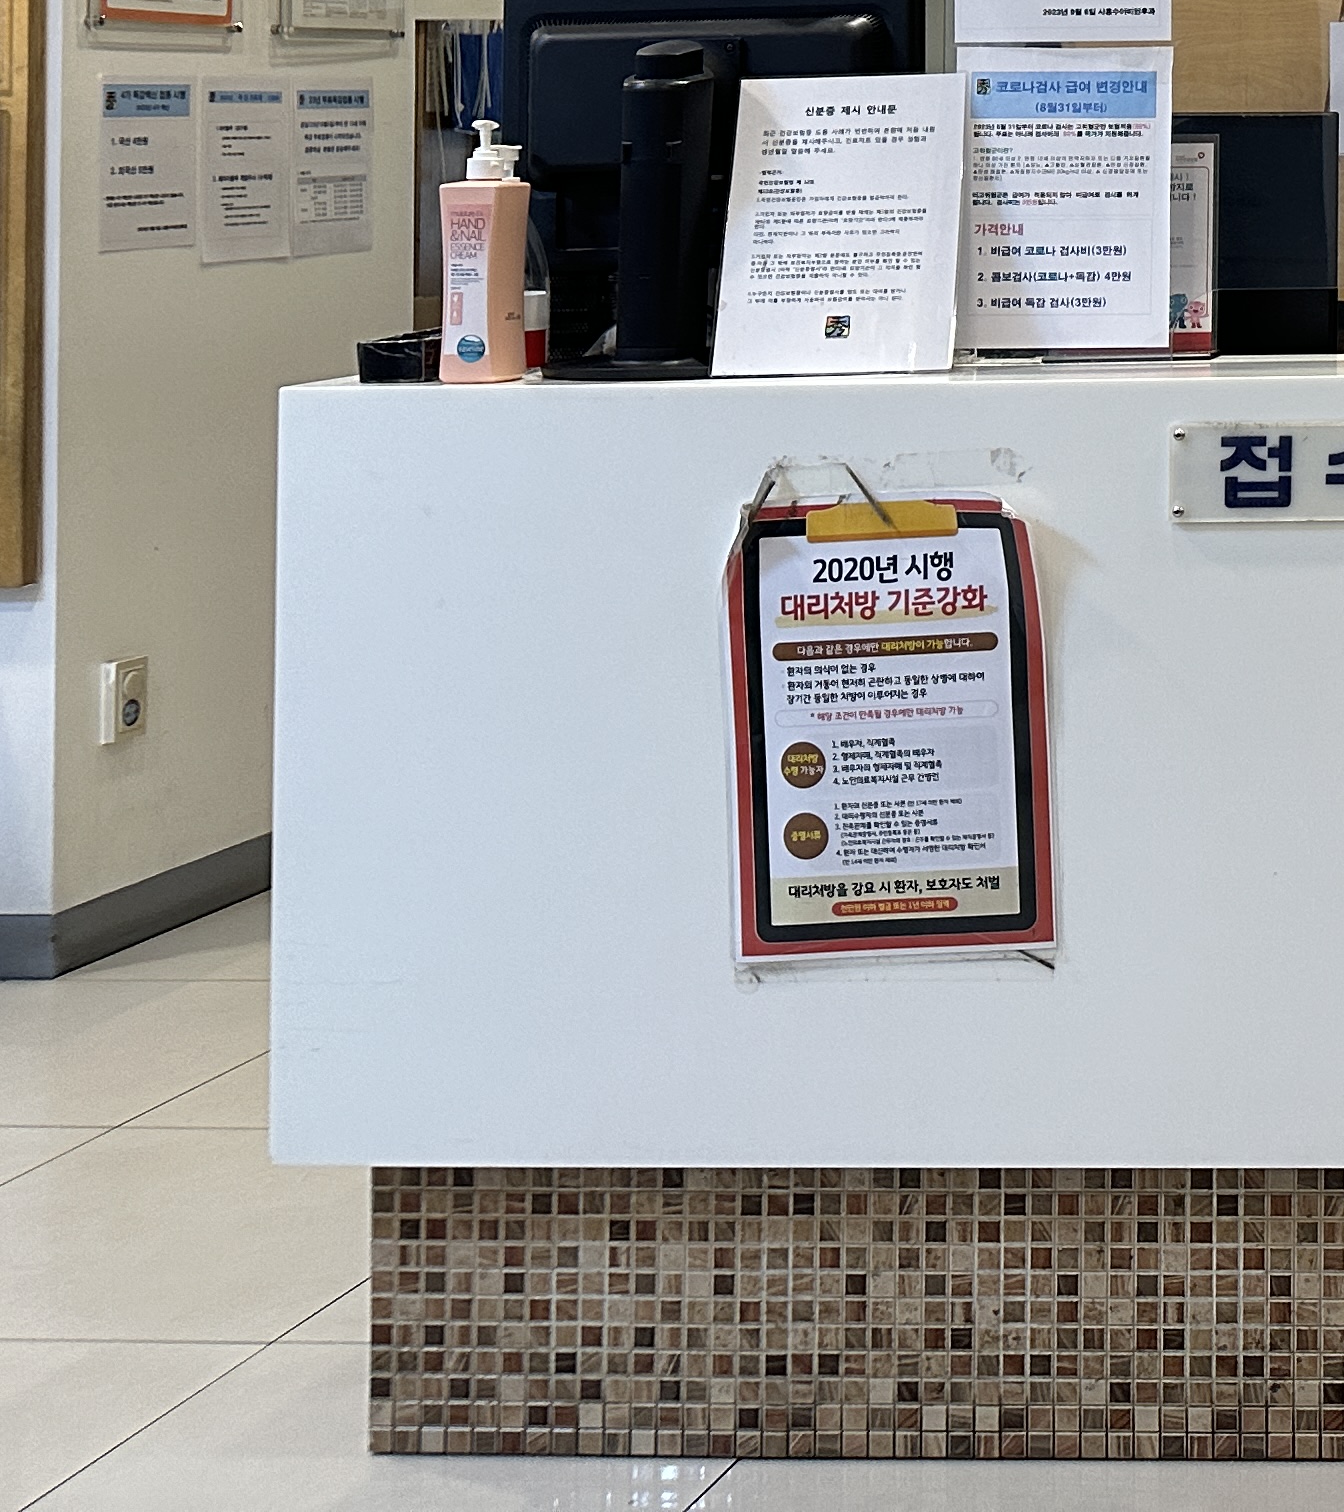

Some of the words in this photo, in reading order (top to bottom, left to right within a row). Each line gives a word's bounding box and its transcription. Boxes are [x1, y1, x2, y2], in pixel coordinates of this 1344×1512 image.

[996, 81, 1060, 93] 코로나검사
[1065, 81, 1091, 93] 급여
[1096, 80, 1147, 93] 변경안내
[805, 106, 835, 116] 신분증
[841, 105, 861, 115] 제시
[867, 104, 897, 115] 안내문
[1035, 102, 1107, 113] (8월31일부터)
[451, 219, 486, 230] HAND
[974, 223, 1024, 236] 가격안내
[977, 247, 987, 256] 1.
[991, 246, 1021, 257] 비급여
[1025, 246, 1056, 256] 코로나
[1060, 245, 1127, 257] 검사비(3만원)
[977, 272, 987, 282] 2.
[1105, 270, 1131, 282] 4만원
[976, 298, 987, 308] 3.
[991, 297, 1022, 308] 비급여
[1025, 297, 1046, 309] 독감
[1050, 296, 1107, 309] 검사(3만원)
[813, 555, 898, 583] 2020년
[905, 551, 953, 582] 시행
[781, 591, 879, 621] 대리처방
[888, 585, 988, 617] 기준강화
[787, 666, 811, 676] 환자의
[814, 666, 838, 675] 의식이
[861, 663, 876, 672] 경우
[787, 681, 812, 691] 환자의
[788, 883, 848, 898] 대리처방을
[851, 882, 874, 896] 강요
[879, 881, 890, 894] 시
[894, 880, 922, 894] 환자,
[926, 878, 972, 891] 보호자도
[976, 876, 1000, 890] 처벌
